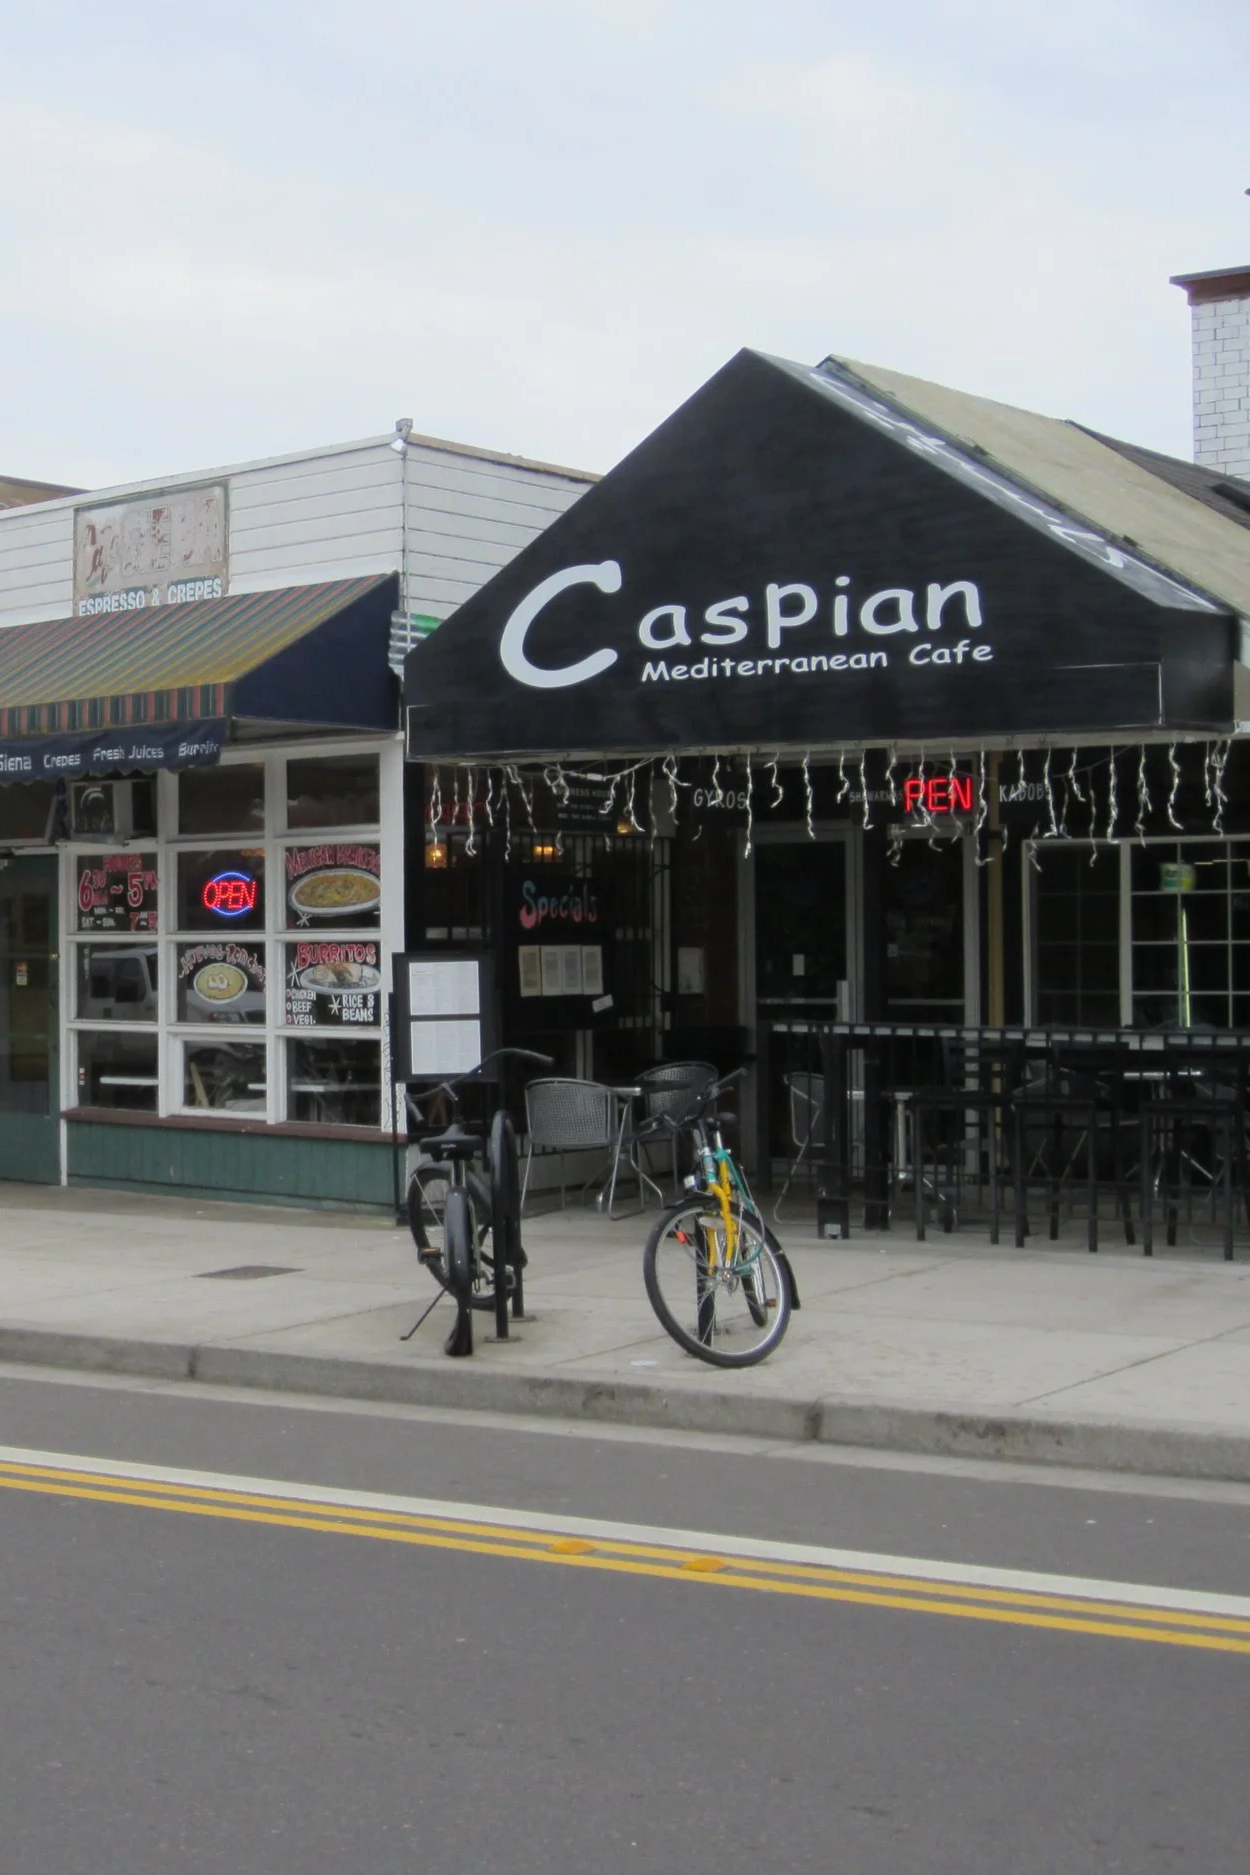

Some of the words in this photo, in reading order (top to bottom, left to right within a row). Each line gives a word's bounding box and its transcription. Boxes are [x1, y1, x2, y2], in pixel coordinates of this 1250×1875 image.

[78, 590, 146, 617] ESPRESSO
[152, 588, 160, 606] &
[168, 577, 222, 604] CREPES
[500, 559, 984, 689] Caspian
[641, 648, 888, 683] Mediterranean
[908, 640, 994, 666] Cafe
[43, 753, 81, 768] Crepes
[93, 746, 125, 761] Fresh
[128, 745, 164, 759] Juices
[693, 788, 746, 811] GYROS
[127, 872, 143, 908] 5
[203, 881, 257, 909] OPEN
[519, 879, 598, 929] Specials
[297, 942, 376, 969] BURRITOS
[291, 989, 317, 1001] CHICKEN
[293, 1001, 312, 1013] BEEF
[342, 994, 363, 1008] RICE
[342, 1009, 374, 1022] BEANS
